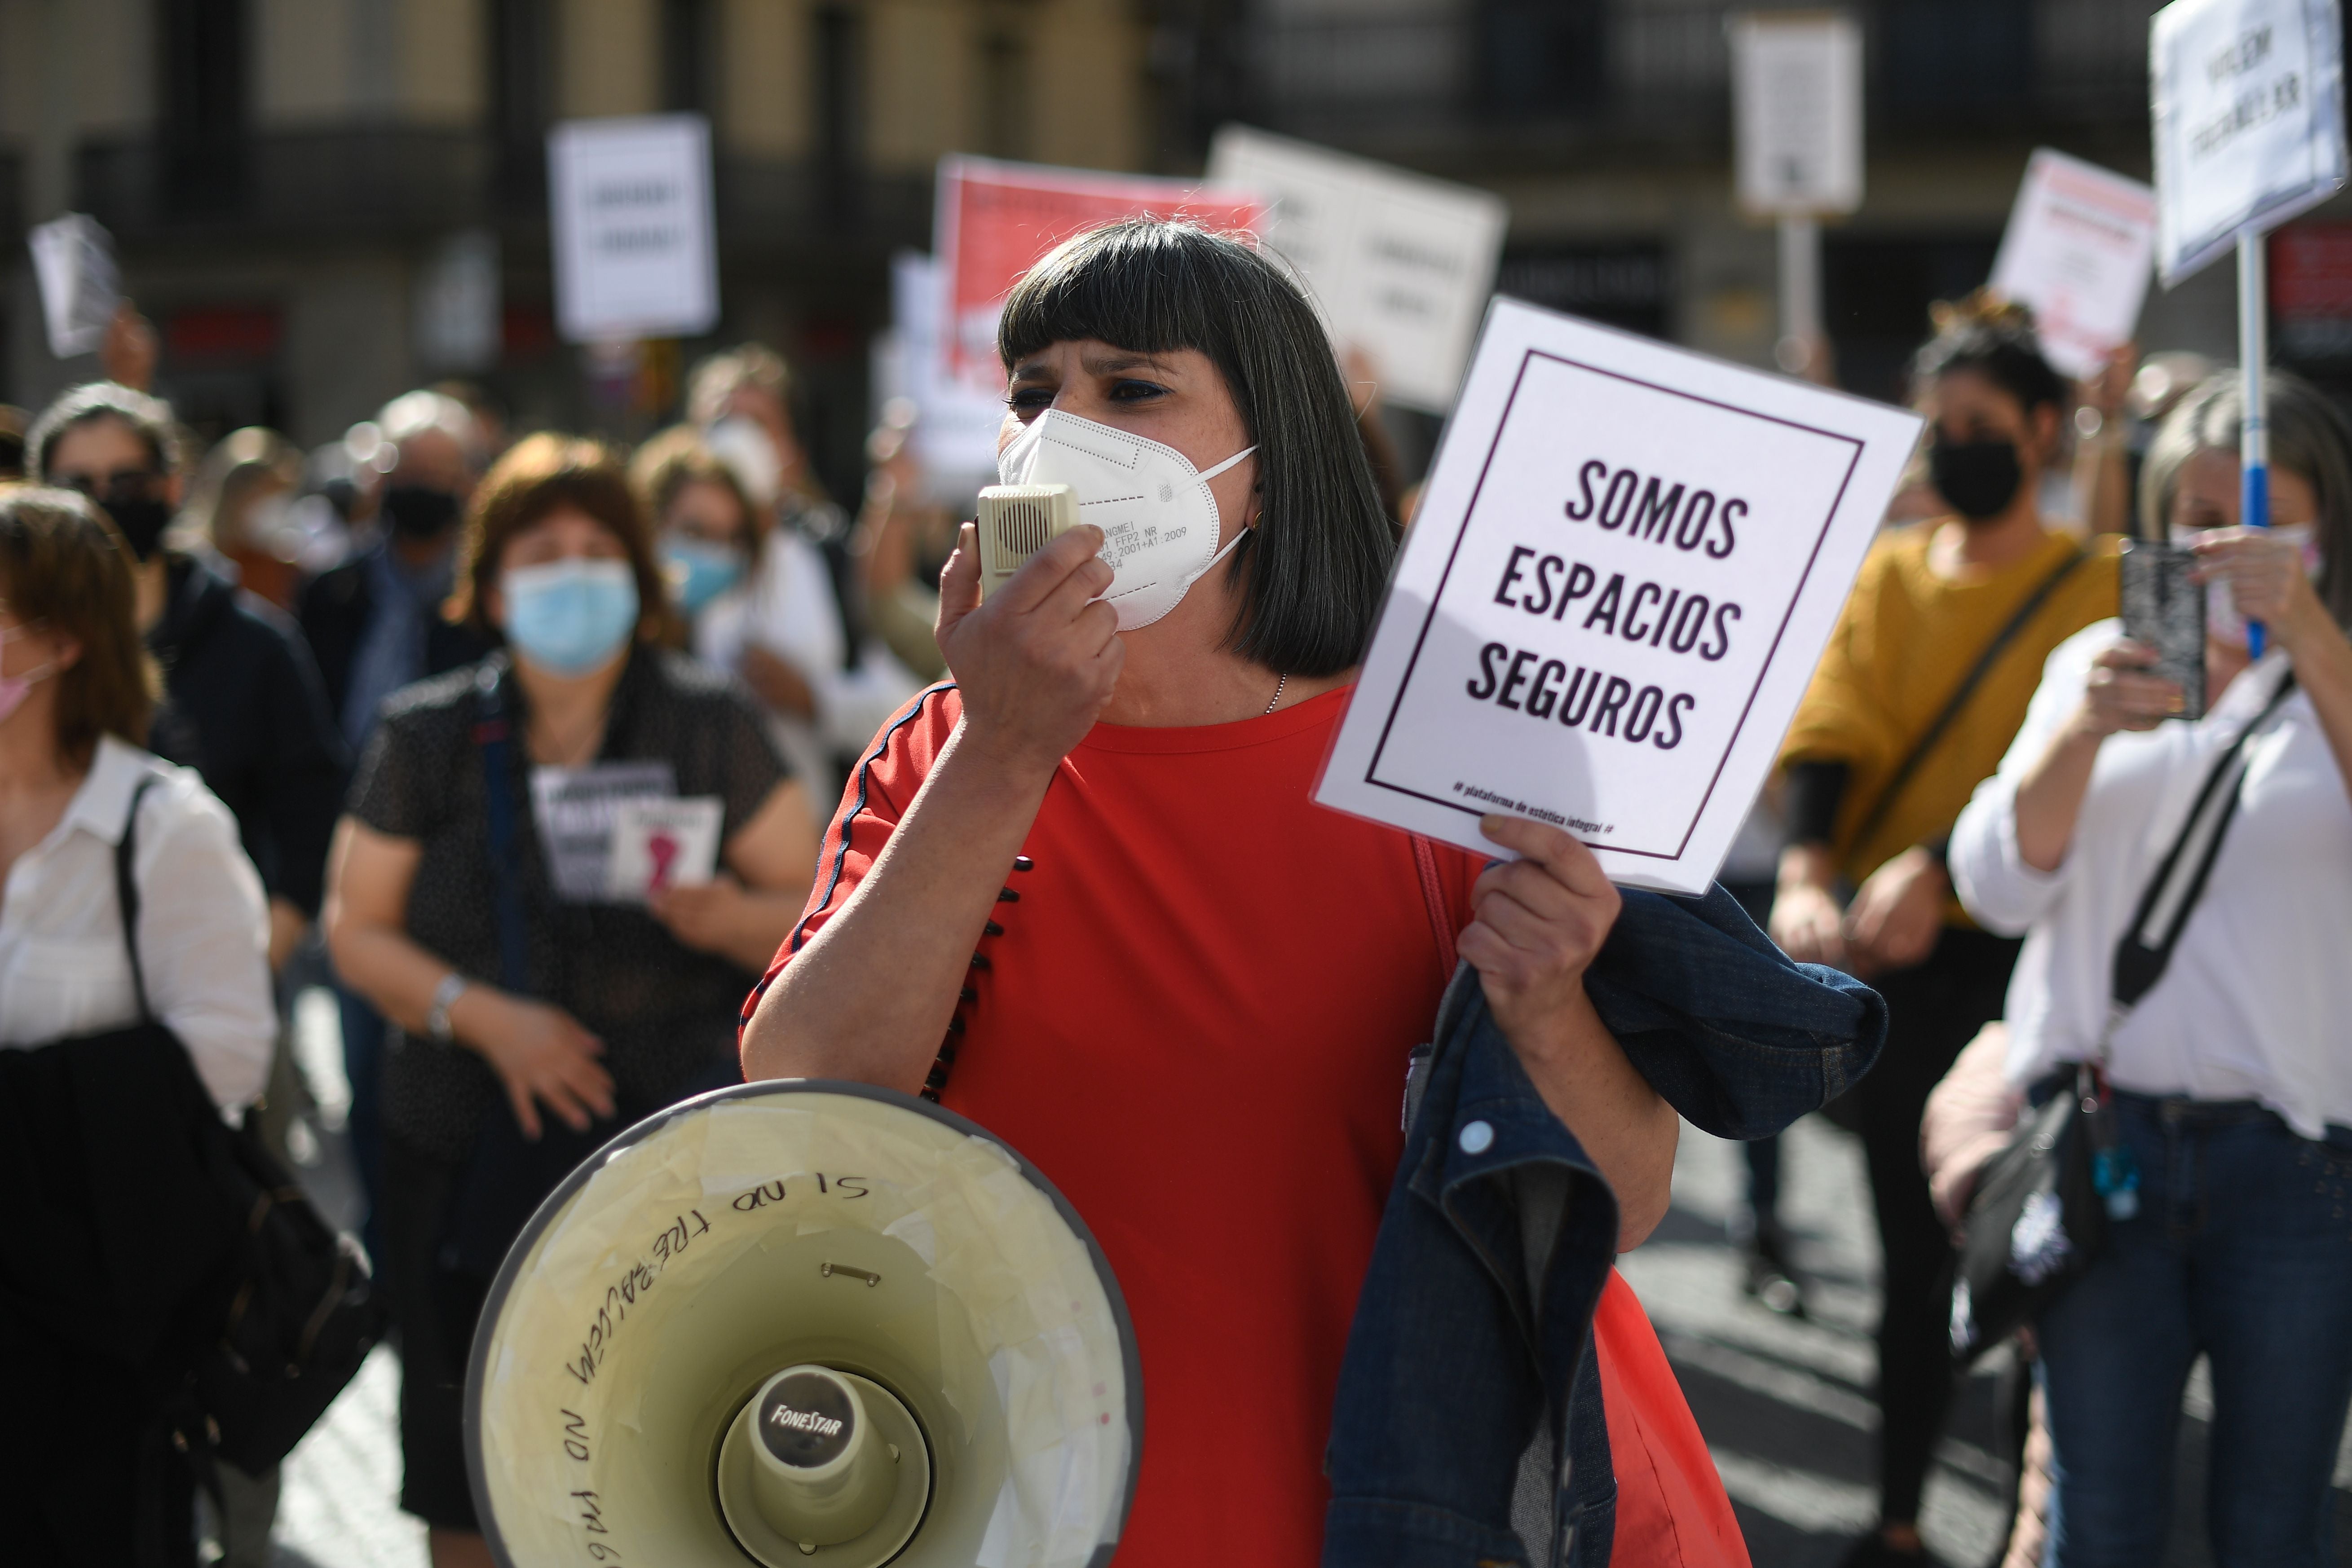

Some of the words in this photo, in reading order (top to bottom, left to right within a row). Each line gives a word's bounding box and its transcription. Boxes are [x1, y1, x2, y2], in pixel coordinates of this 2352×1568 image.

[1104, 521, 1134, 539] NGMEI
[1565, 460, 1748, 559] SOMOS
[1098, 527, 1187, 561] 49:2001+A1:2009
[1116, 532, 1140, 547] FFP2
[1145, 526, 1157, 538] NR
[1493, 545, 1742, 661] ESPACIOS
[1466, 642, 1695, 750] SEGUROS
[1463, 785, 1514, 809] plataforma
[1515, 801, 1527, 813] de
[1566, 816, 1603, 833] integral
[733, 1180, 787, 1211] NO
[816, 1172, 869, 1198] SI
[560, 1408, 590, 1461] NO
[570, 1491, 624, 1568] PAG
